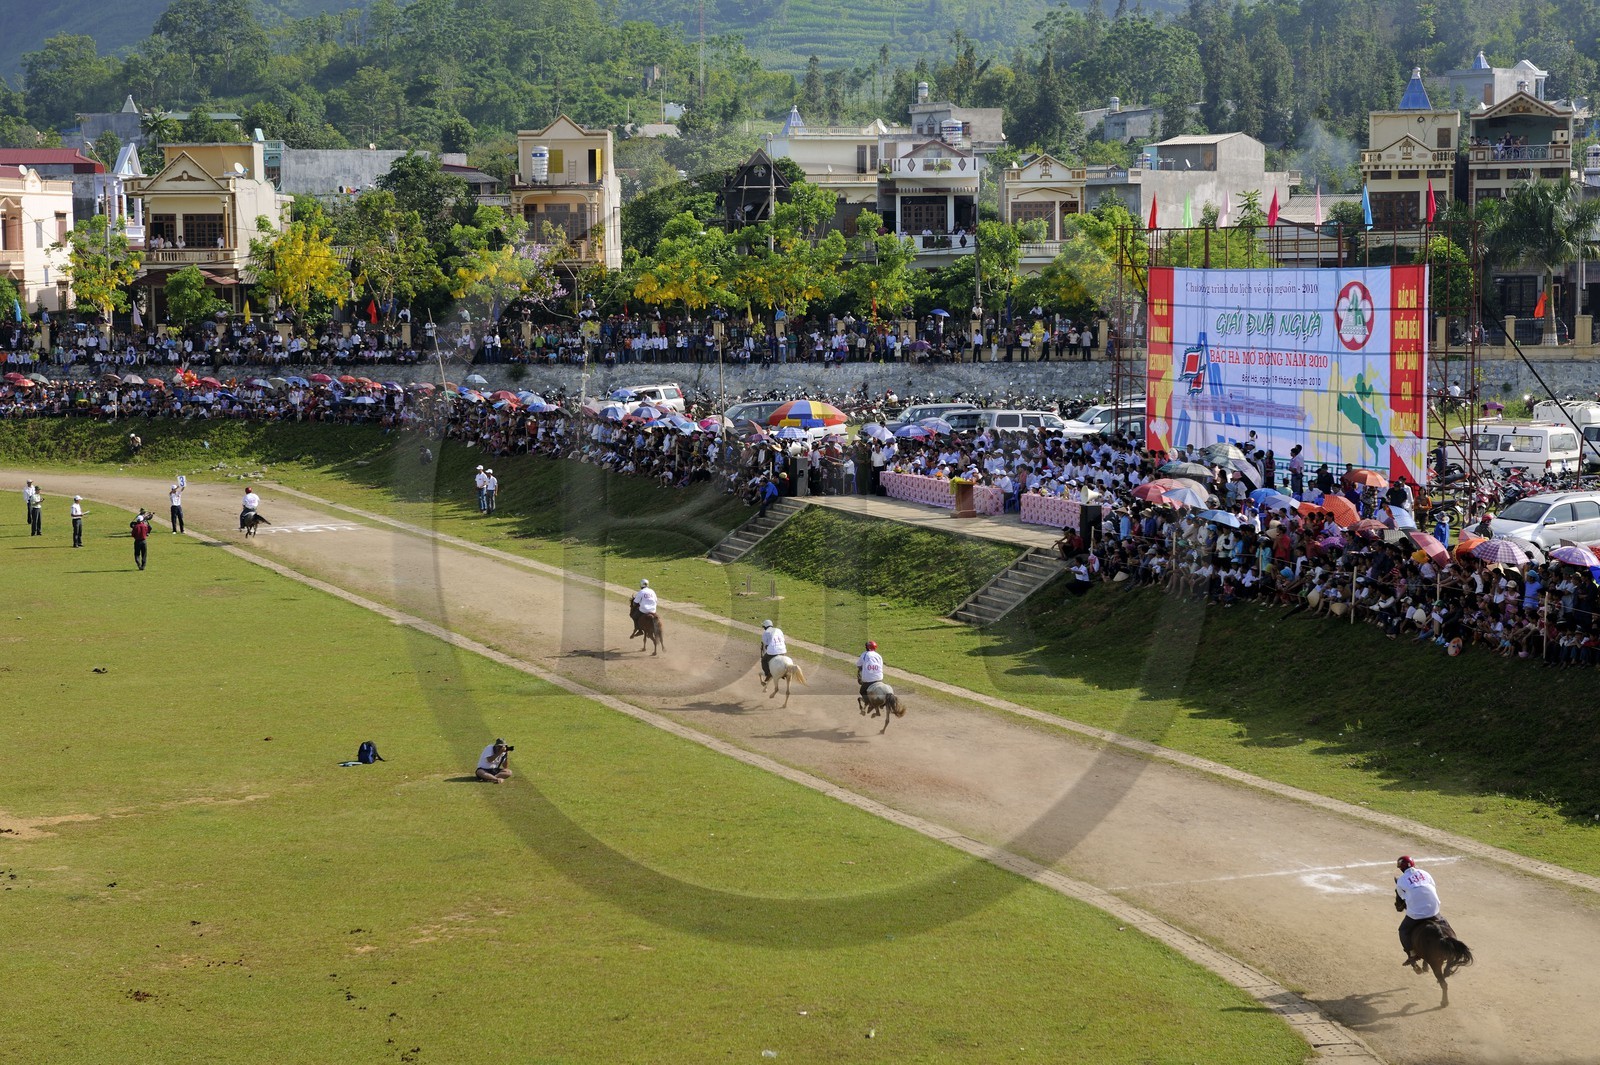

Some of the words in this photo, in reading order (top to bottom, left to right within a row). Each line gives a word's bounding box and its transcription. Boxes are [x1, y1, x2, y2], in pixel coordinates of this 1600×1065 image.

[1229, 283, 1239, 293] du
[1302, 283, 1319, 294] 2010
[1215, 305, 1244, 337] GIẢI
[1246, 312, 1276, 337] ĐUA
[1209, 343, 1227, 364] BẮC
[1228, 347, 1241, 365] HÀ
[1242, 345, 1257, 366] MỞ
[1258, 348, 1284, 369] RỘNG
[1285, 350, 1307, 368] NĂM
[1308, 355, 1329, 369] 2010
[1309, 377, 1322, 386] 2010
[179, 476, 185, 487] 3
[1407, 871, 1426, 885] 134
